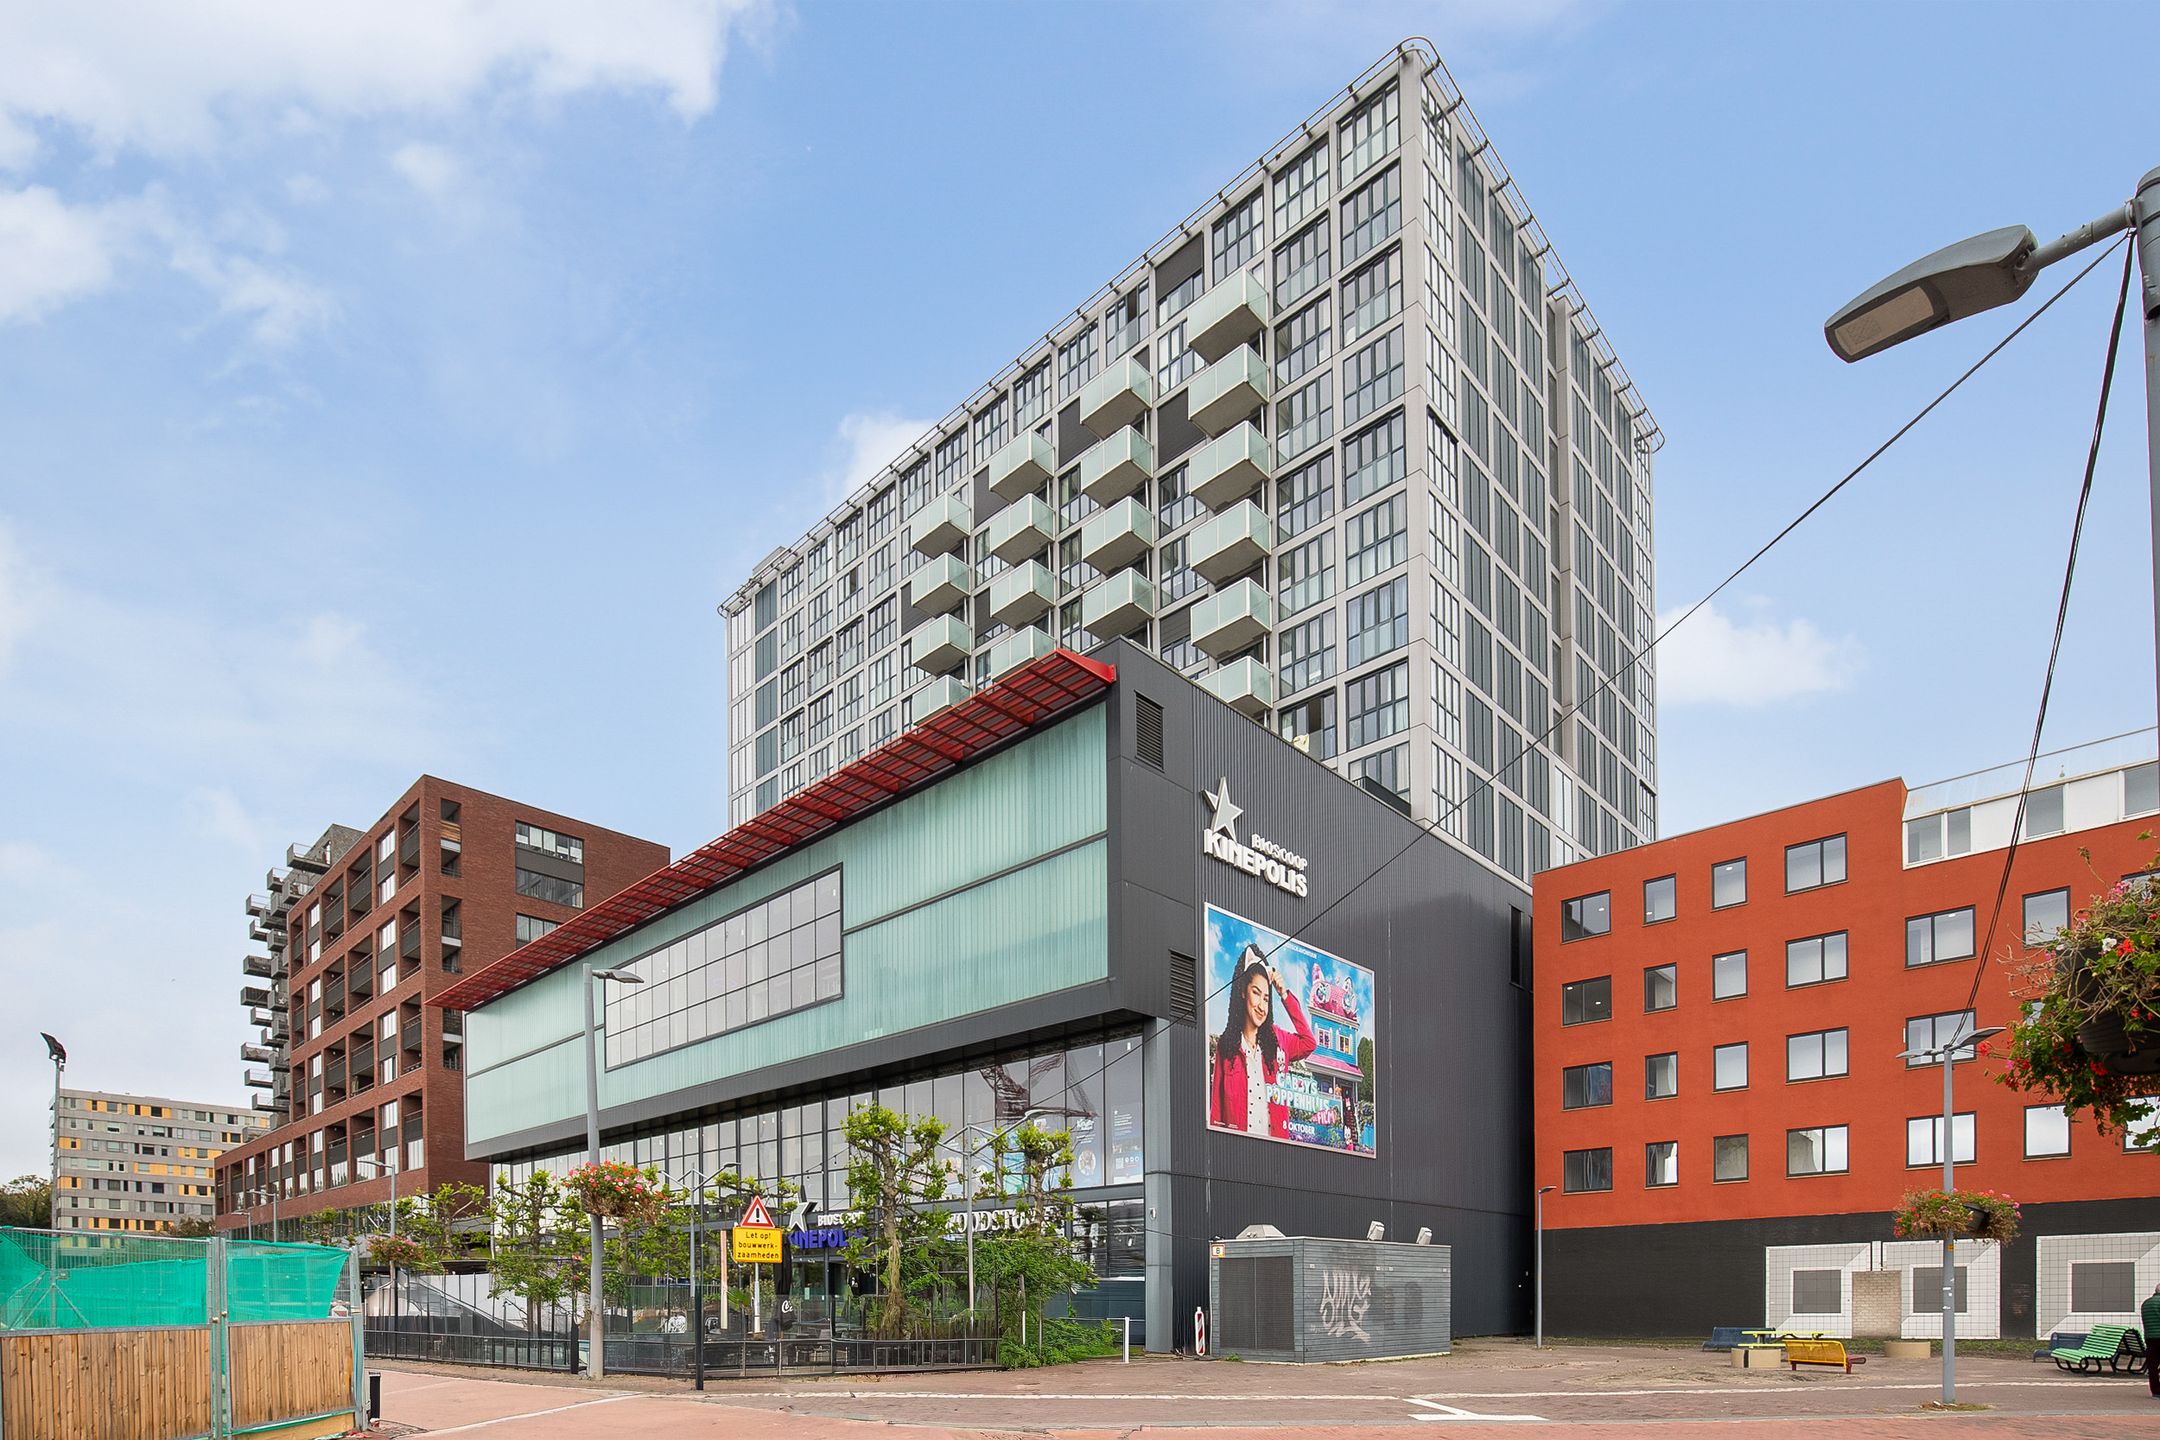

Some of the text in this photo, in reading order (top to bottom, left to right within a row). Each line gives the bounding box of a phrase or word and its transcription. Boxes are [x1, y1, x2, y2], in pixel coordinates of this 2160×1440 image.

[1251, 833, 1308, 871] BIOSCOOP
[1203, 828, 1308, 898] KINEPOLIS
[1317, 1110, 1335, 1125] FILM
[1282, 1120, 1315, 1136] 8 OKTOBER
[760, 1232, 771, 1240] op!
